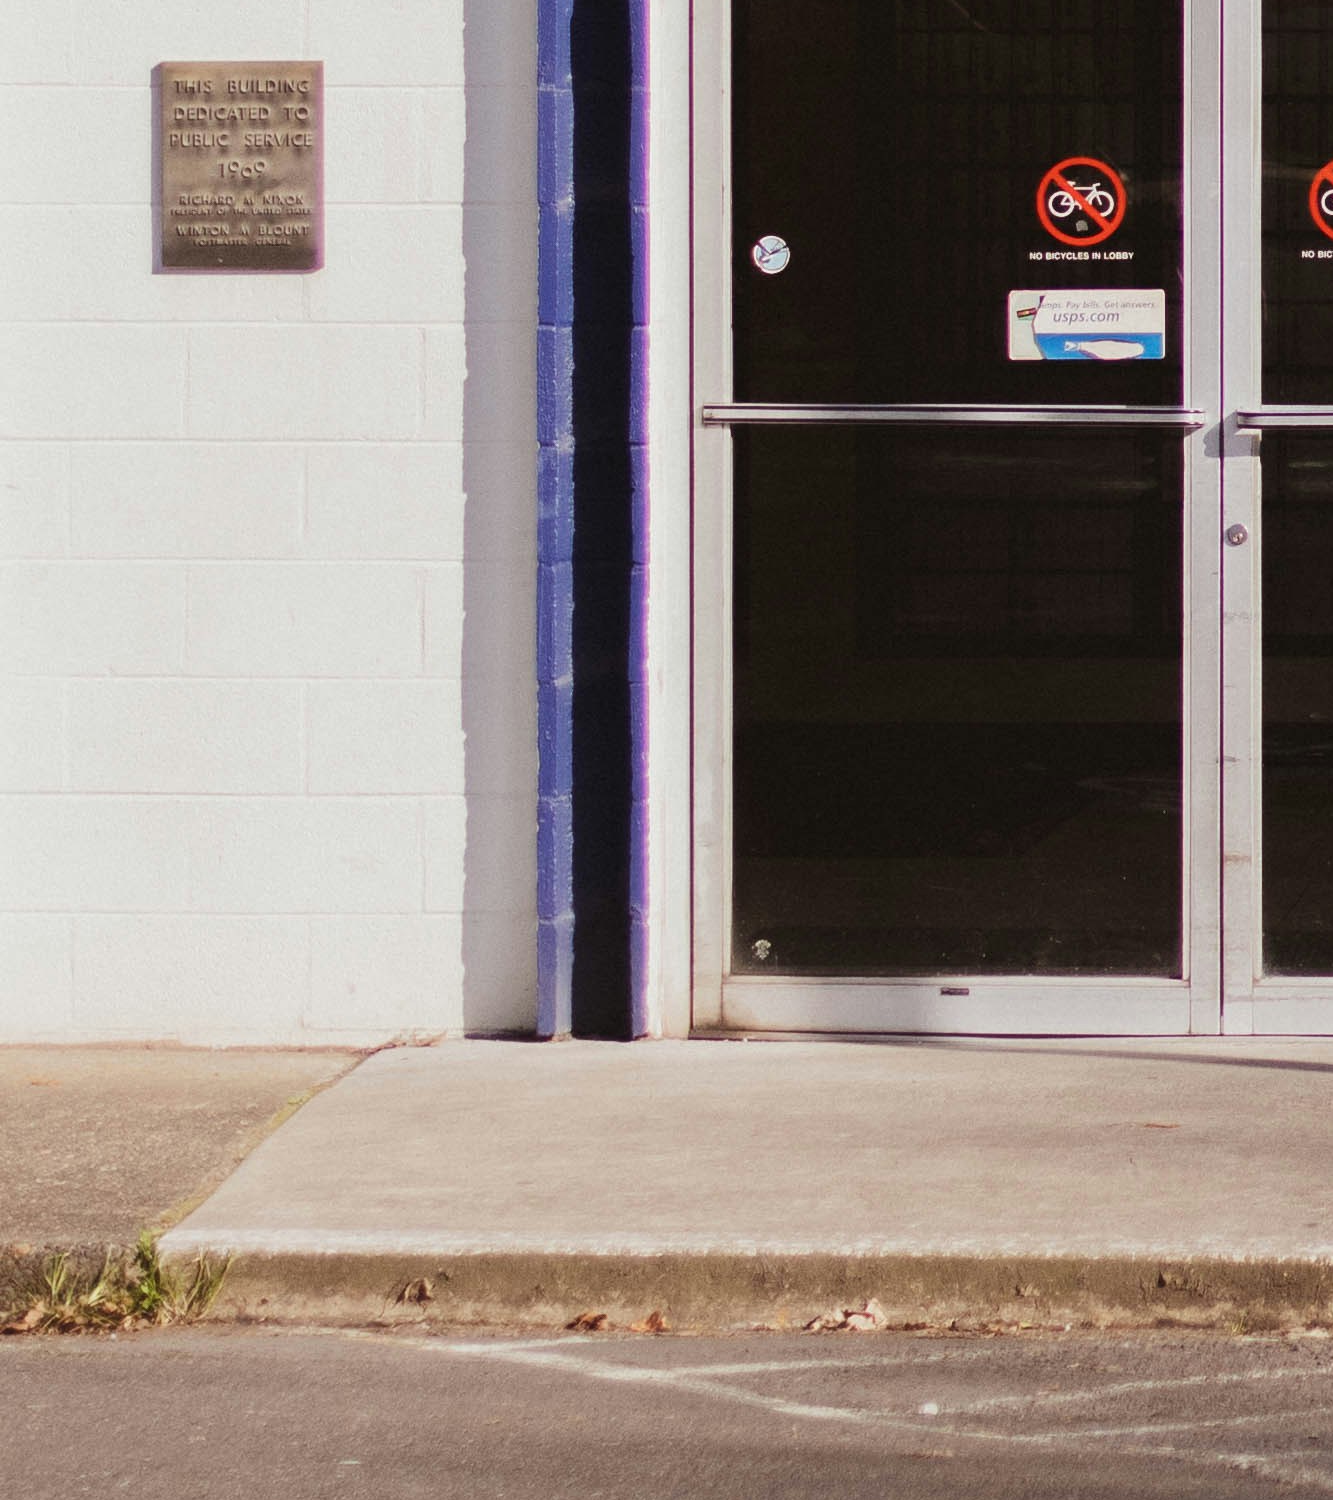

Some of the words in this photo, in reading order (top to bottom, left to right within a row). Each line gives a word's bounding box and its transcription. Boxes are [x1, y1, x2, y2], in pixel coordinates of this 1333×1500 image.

[174, 79, 213, 94] THIS
[227, 79, 310, 95] BUILDING
[174, 107, 270, 121] DEDICATED
[283, 107, 310, 121] TO
[169, 133, 229, 148] PUBLIC
[244, 133, 313, 148] SERVICE
[178, 195, 234, 206] RICHARD
[263, 195, 304, 205] NIXON
[176, 225, 230, 237] WINTON
[258, 224, 310, 236] BLOUNT
[1029, 251, 1043, 260] NO
[1045, 251, 1089, 260] BICYCLES
[1091, 251, 1101, 260] IN
[1103, 251, 1135, 260] LOBBY
[1301, 250, 1315, 259] NO
[1052, 311, 1120, 325] usps.com
